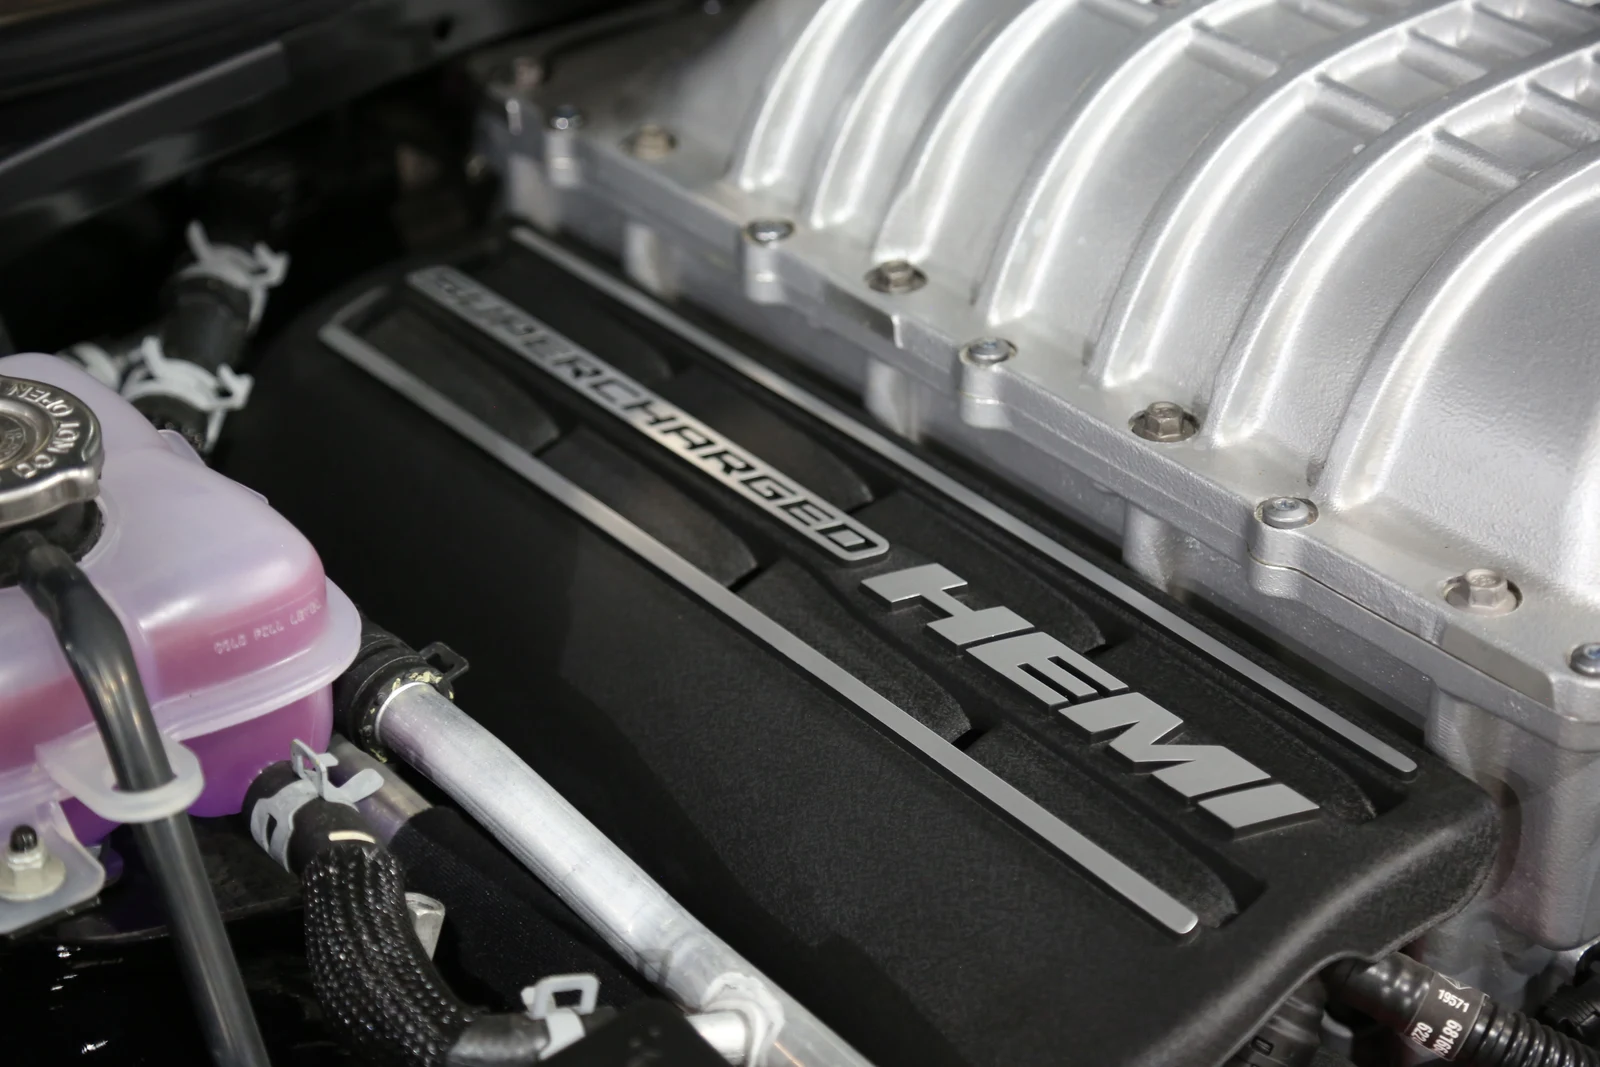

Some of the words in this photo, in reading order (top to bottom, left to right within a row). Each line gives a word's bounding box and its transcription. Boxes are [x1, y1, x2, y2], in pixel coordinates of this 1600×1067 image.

[8, 383, 73, 417] OPEN
[860, 562, 1320, 832] HEMI
[1436, 988, 1471, 1013] 19571
